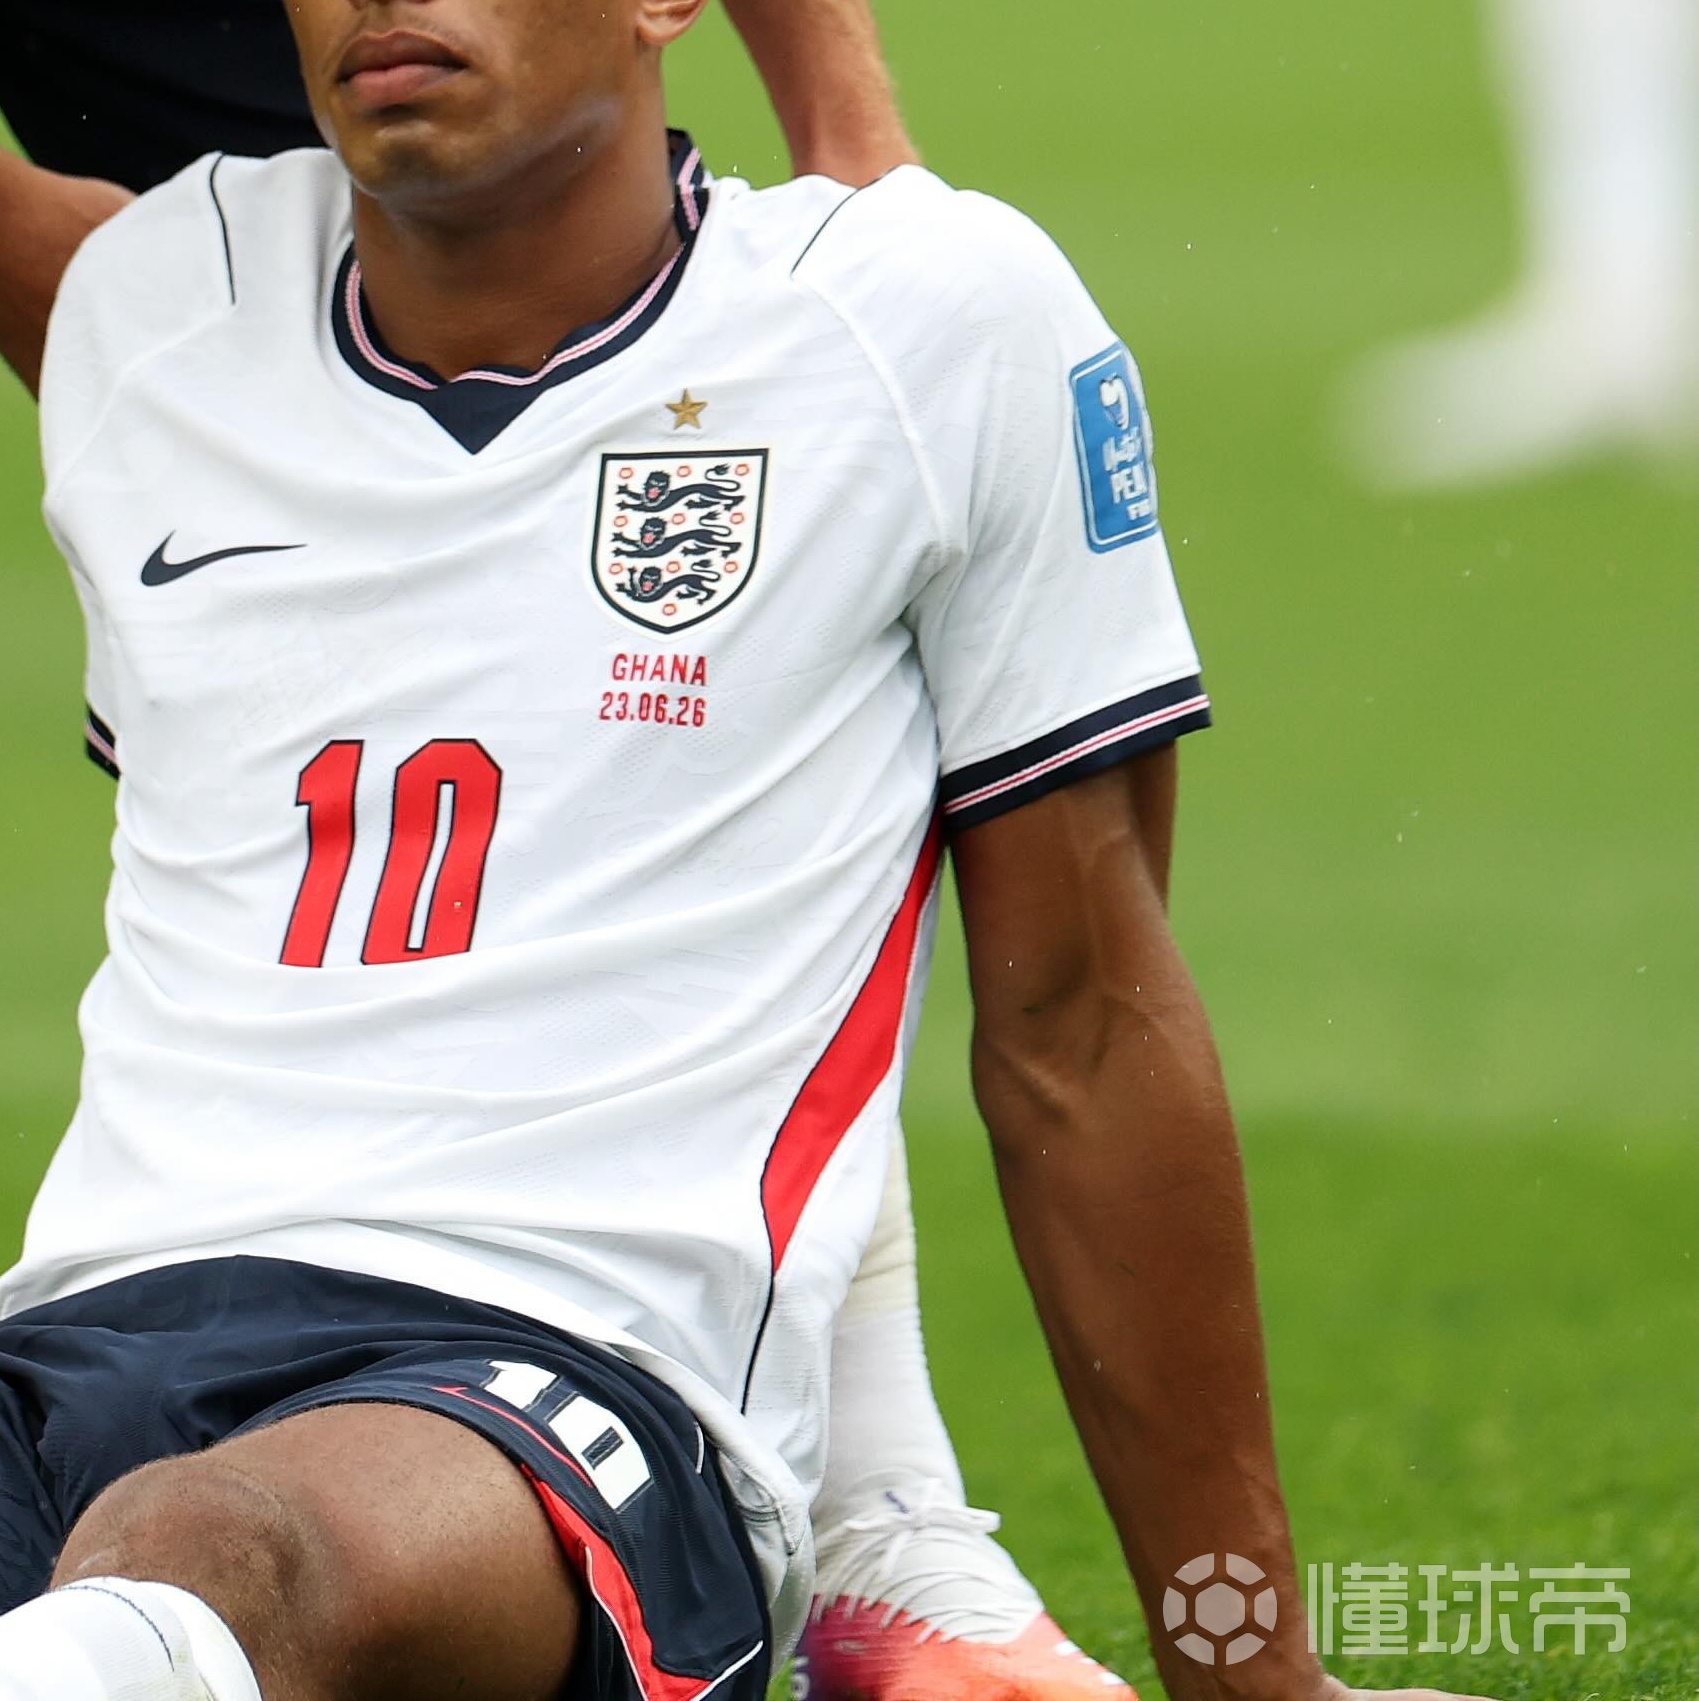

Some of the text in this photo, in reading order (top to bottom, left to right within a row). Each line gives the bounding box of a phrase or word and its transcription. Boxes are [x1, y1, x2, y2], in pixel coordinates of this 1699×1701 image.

[599, 691, 707, 728] 23.06.26
[612, 652, 707, 687] GHANA
[278, 738, 502, 968] 10
[480, 1359, 653, 1513] 10
